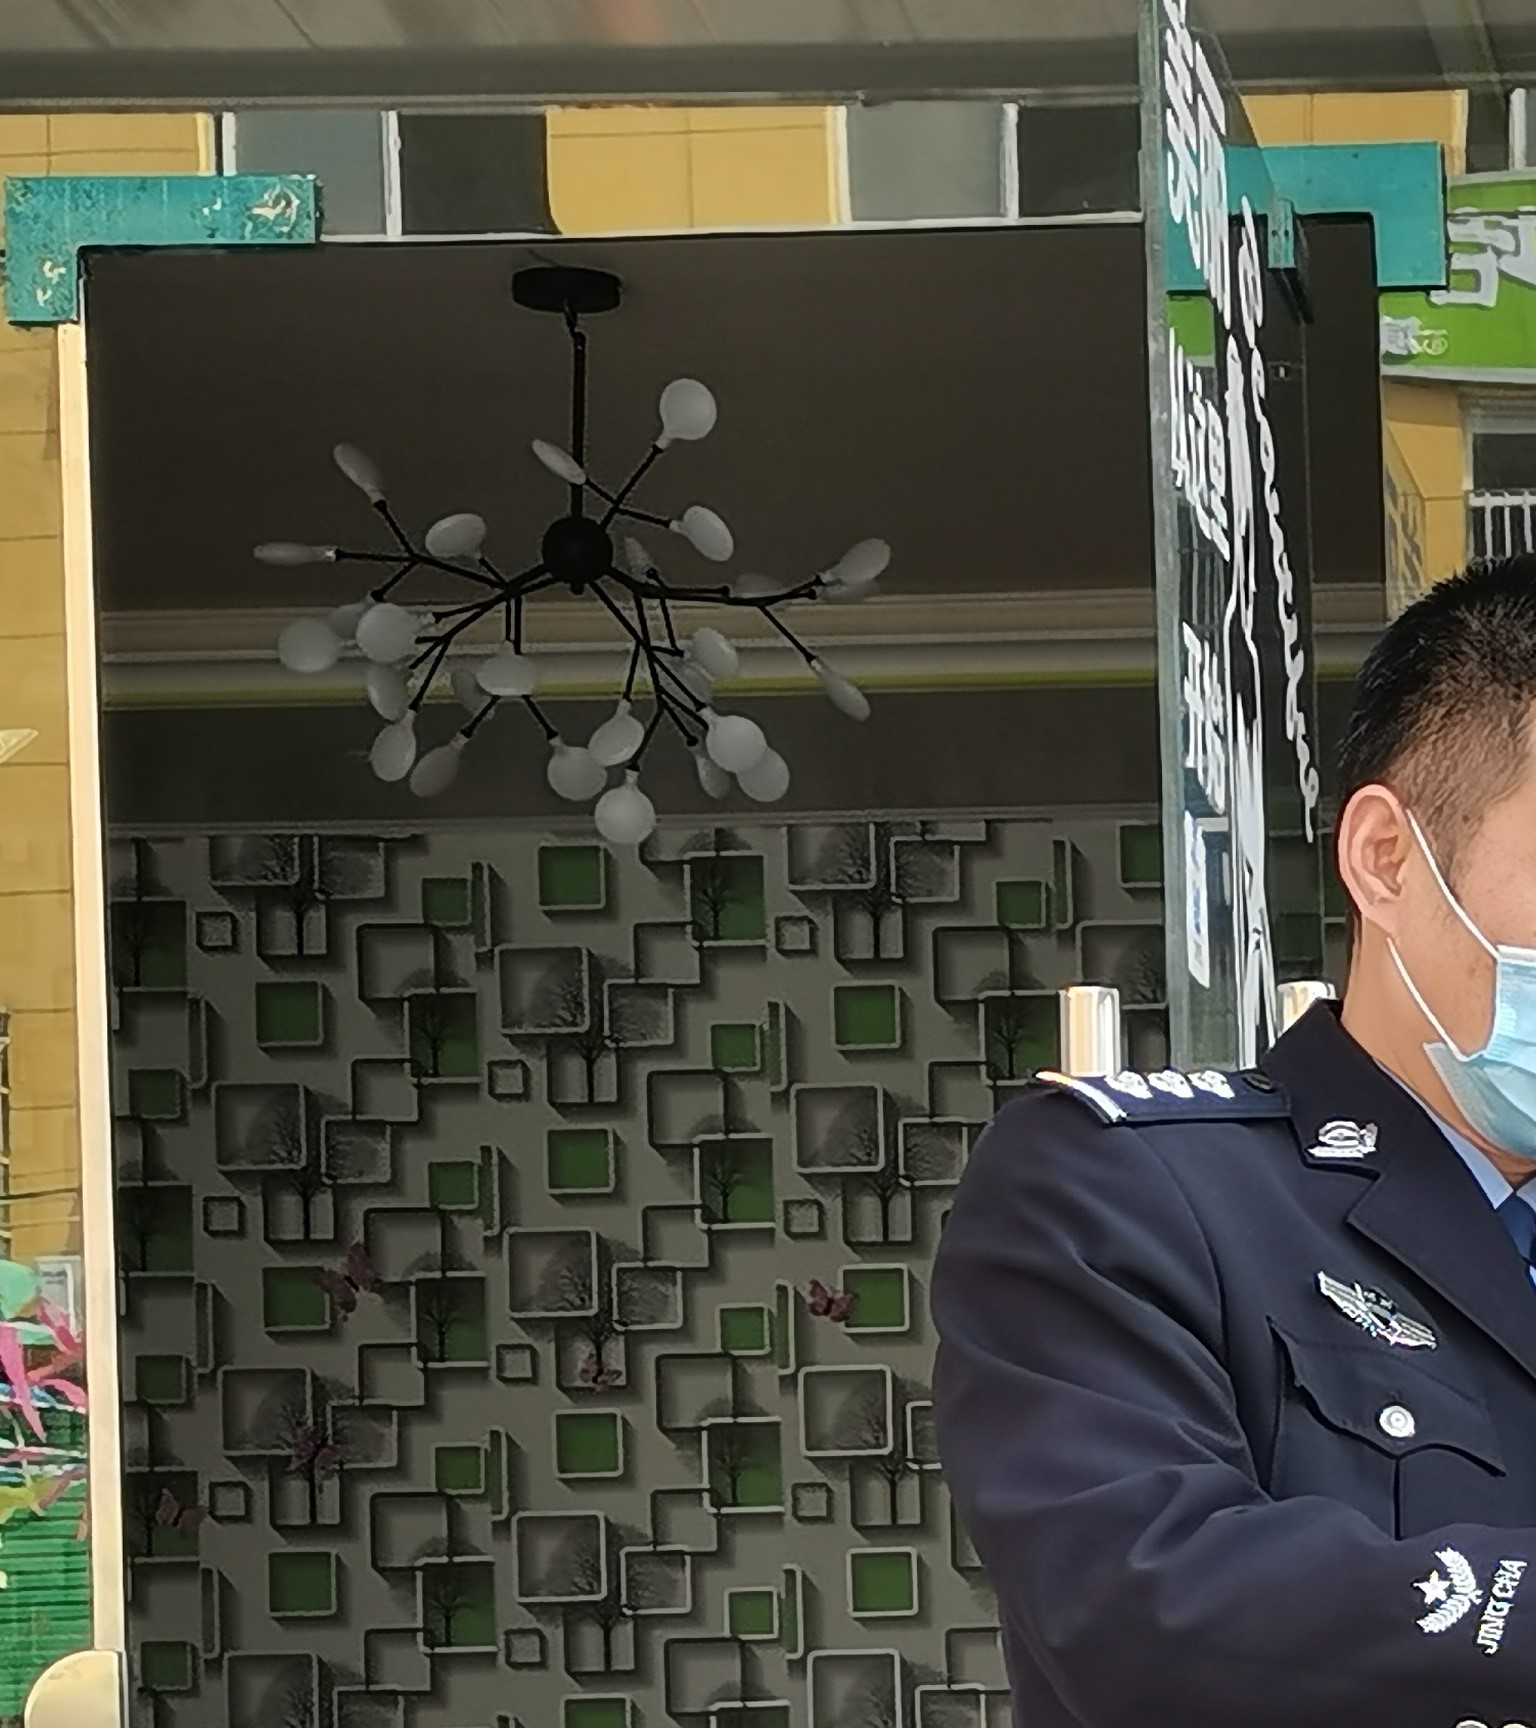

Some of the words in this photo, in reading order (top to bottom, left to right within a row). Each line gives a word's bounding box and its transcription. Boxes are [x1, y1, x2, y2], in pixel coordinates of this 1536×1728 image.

[1169, 329, 1231, 564] 从这里
[1182, 622, 1226, 815] 开始
[1476, 1598, 1513, 1654] JING
